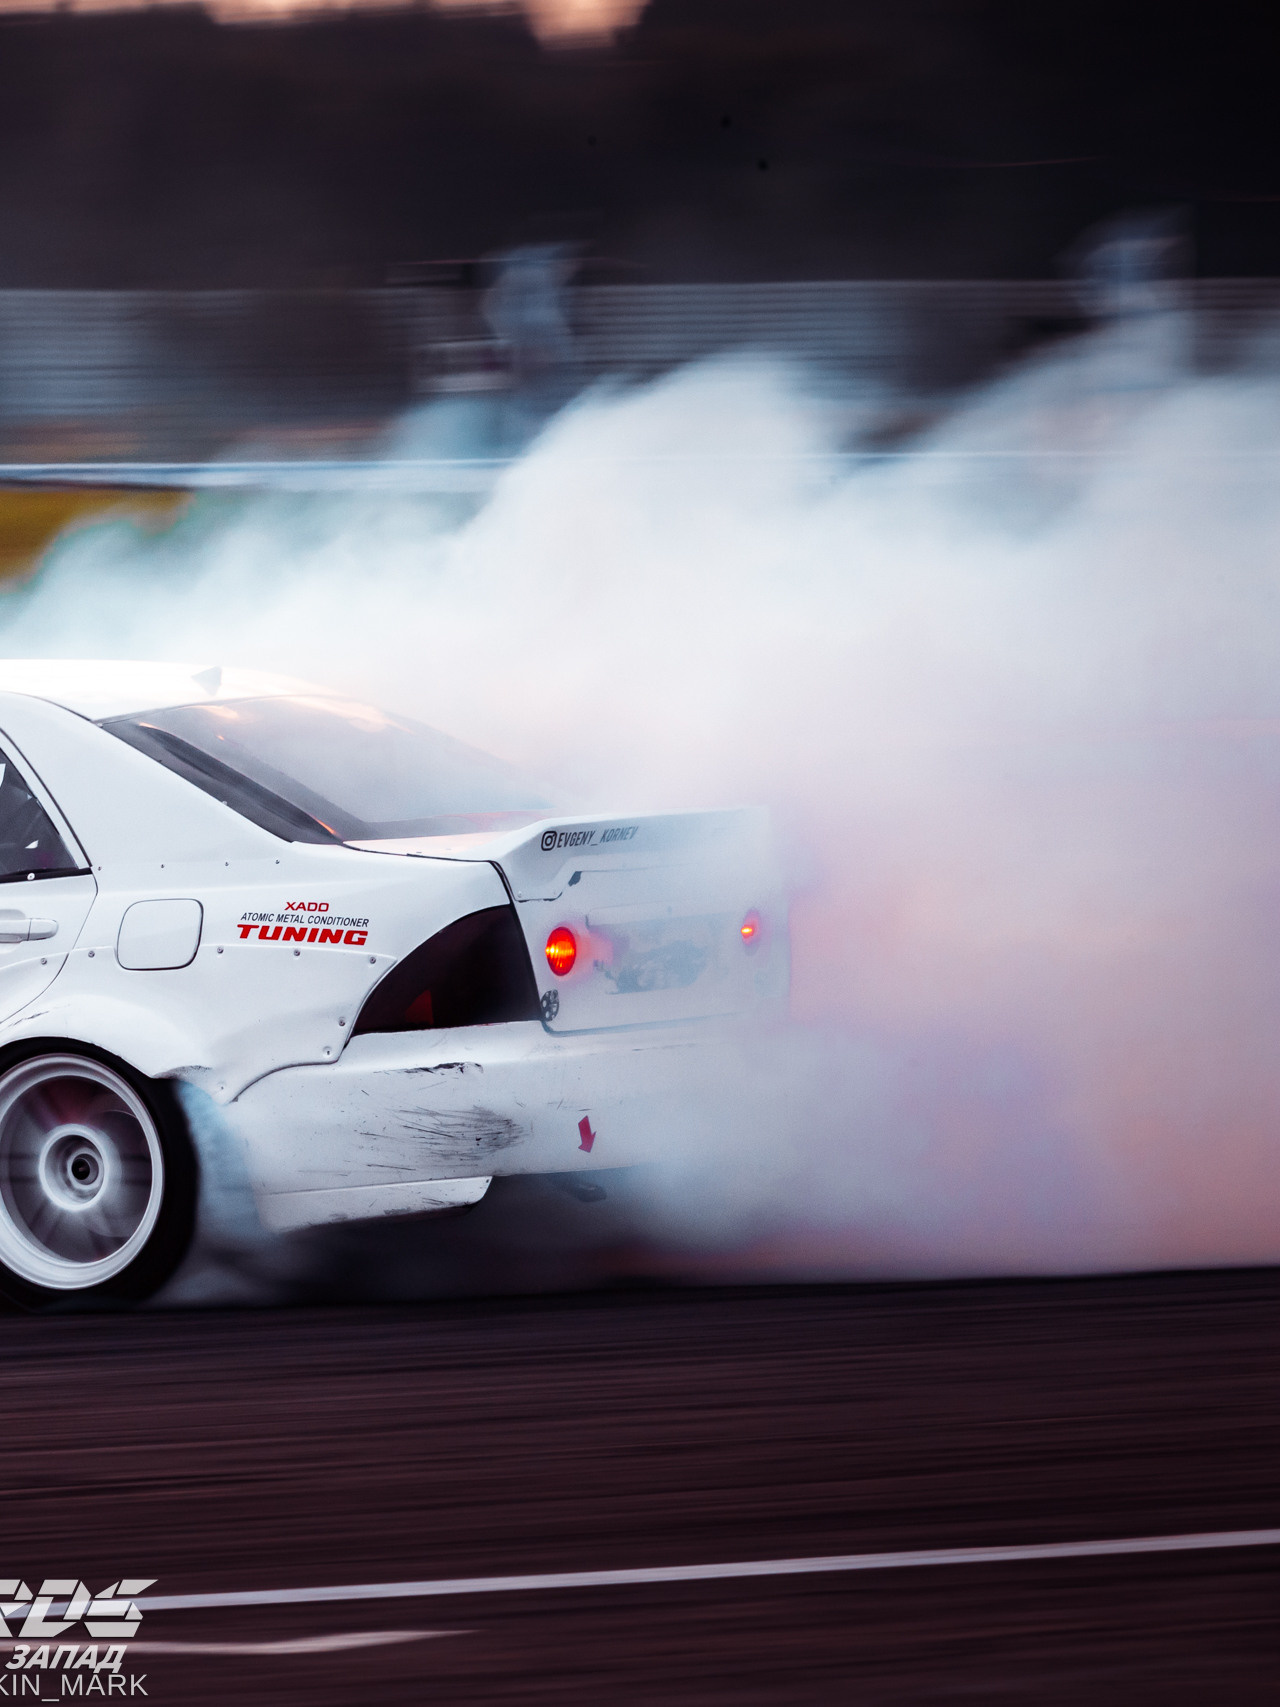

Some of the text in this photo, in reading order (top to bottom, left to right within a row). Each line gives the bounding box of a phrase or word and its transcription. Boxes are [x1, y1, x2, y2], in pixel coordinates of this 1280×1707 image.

[284, 902, 329, 912] XADO
[240, 912, 369, 928] ATOMIC METAL CONDITIONER
[237, 924, 368, 945] TUNING
